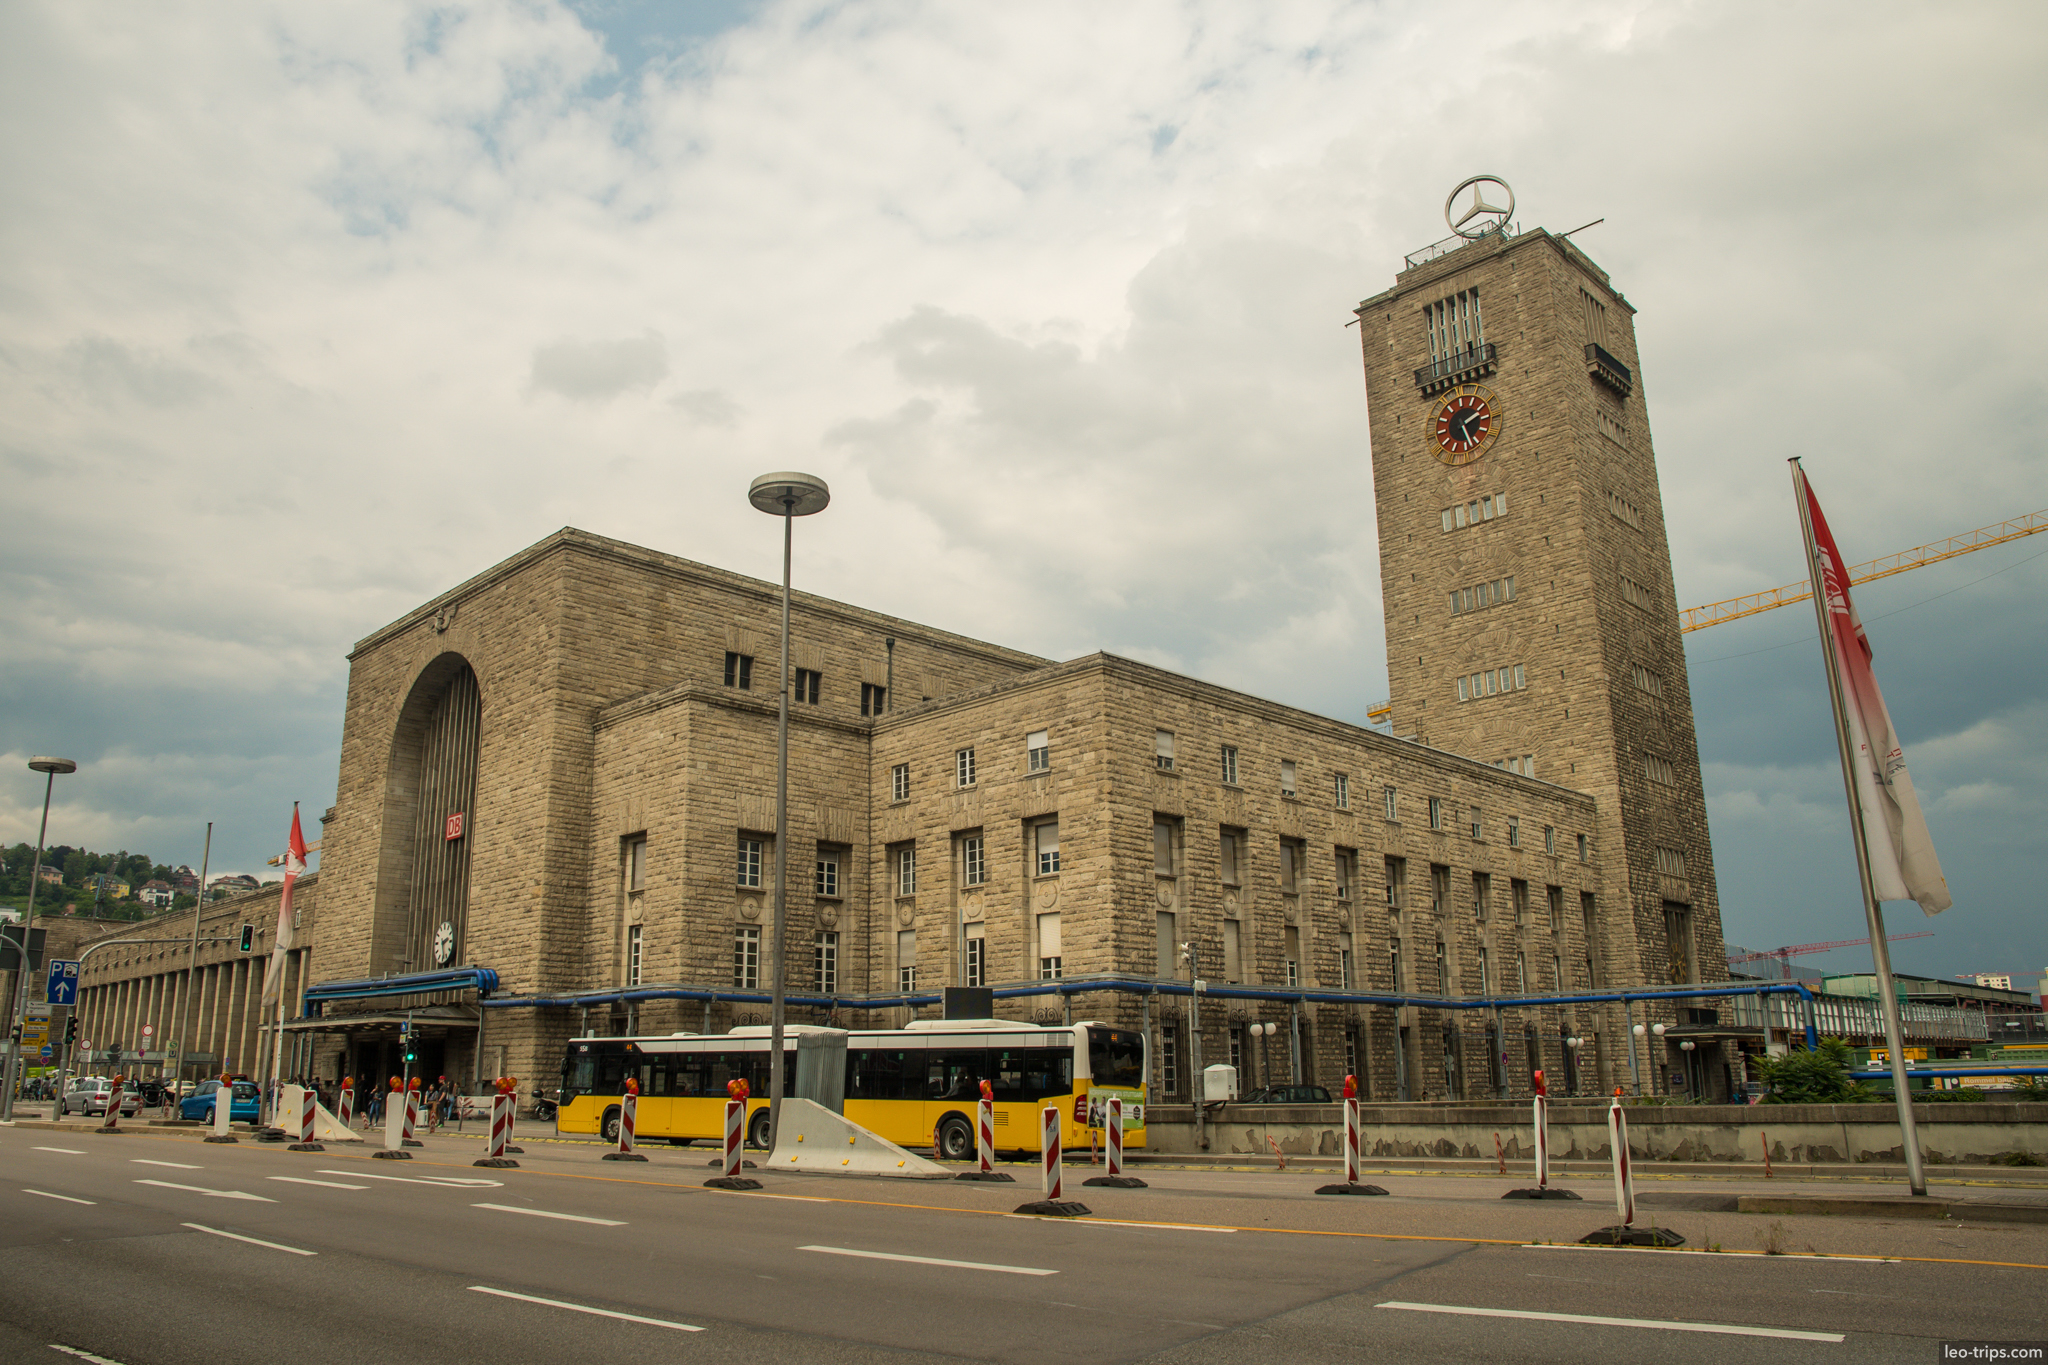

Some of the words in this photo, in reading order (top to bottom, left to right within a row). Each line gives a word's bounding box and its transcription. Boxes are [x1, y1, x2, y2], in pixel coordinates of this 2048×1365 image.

[449, 817, 461, 835] DB
[51, 962, 63, 977] P
[1964, 1076, 1996, 1084] Rommel
